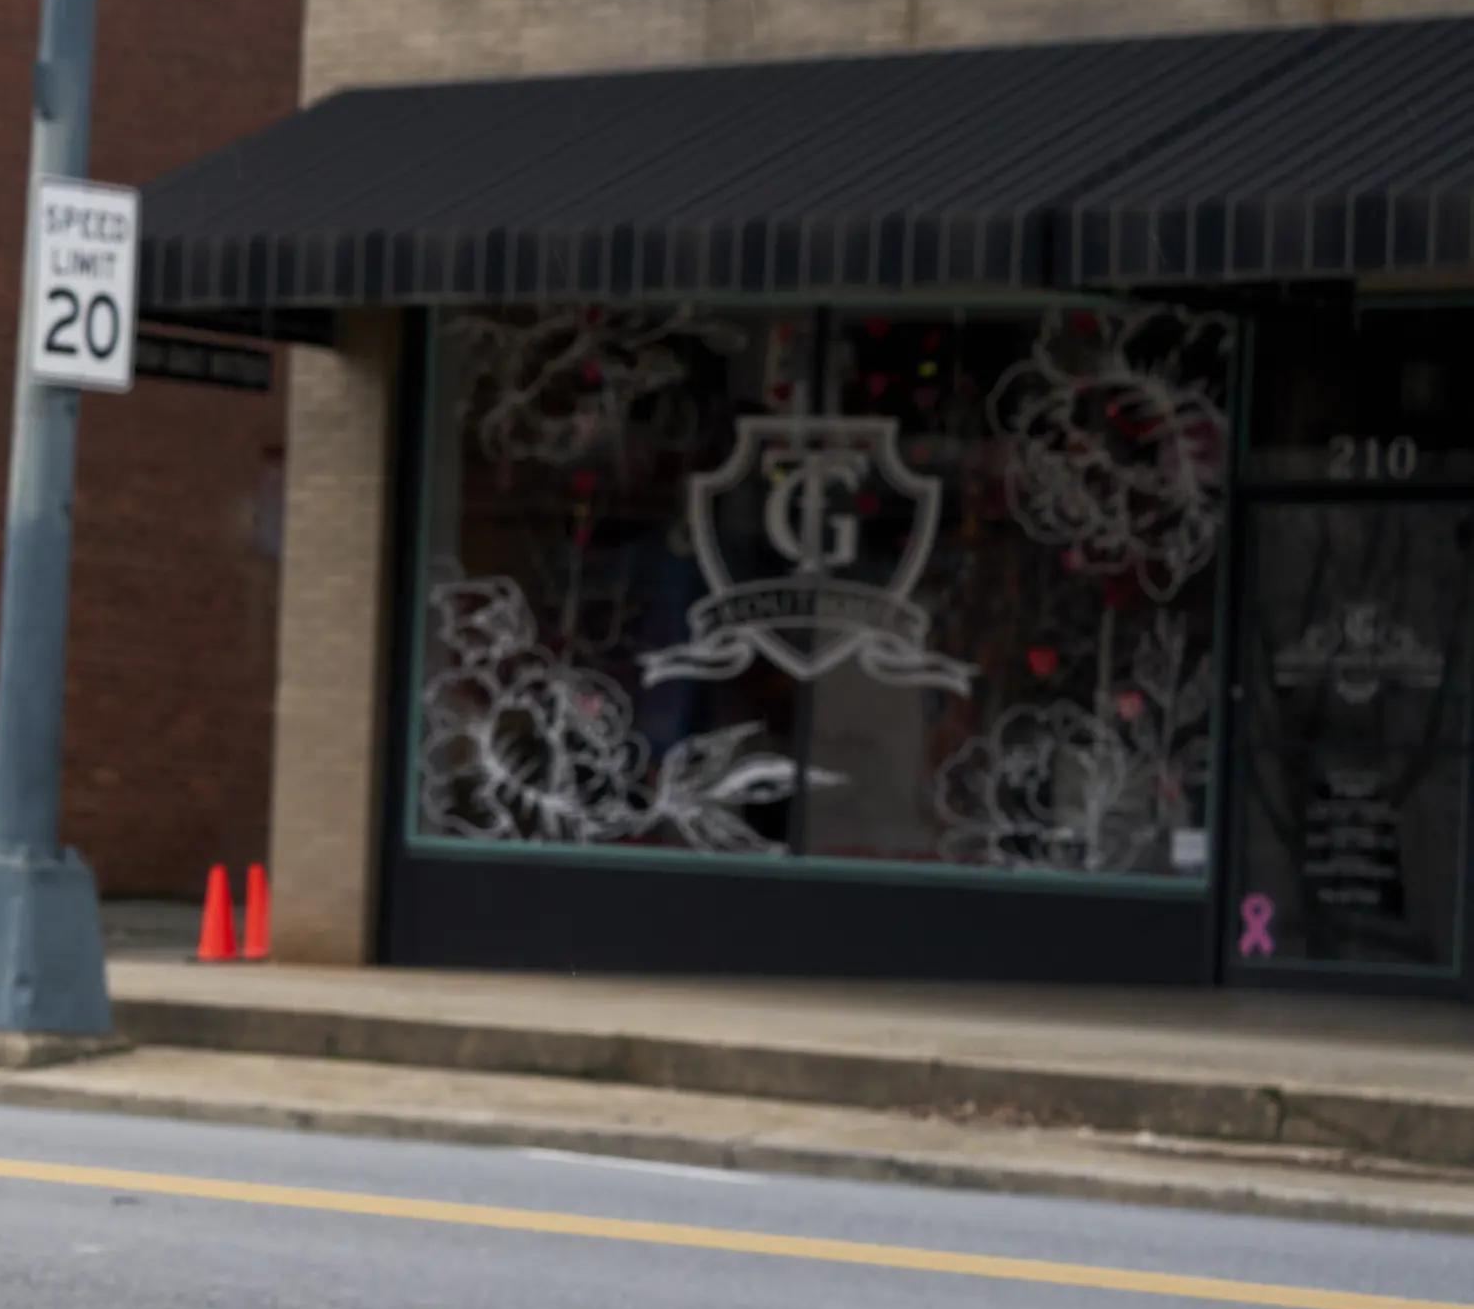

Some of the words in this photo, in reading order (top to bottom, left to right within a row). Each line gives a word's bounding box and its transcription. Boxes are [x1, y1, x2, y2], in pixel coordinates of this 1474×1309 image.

[46, 204, 128, 243] SPEED
[50, 248, 117, 279] LIMIT
[43, 287, 121, 362] 20
[1328, 435, 1417, 479] 210
